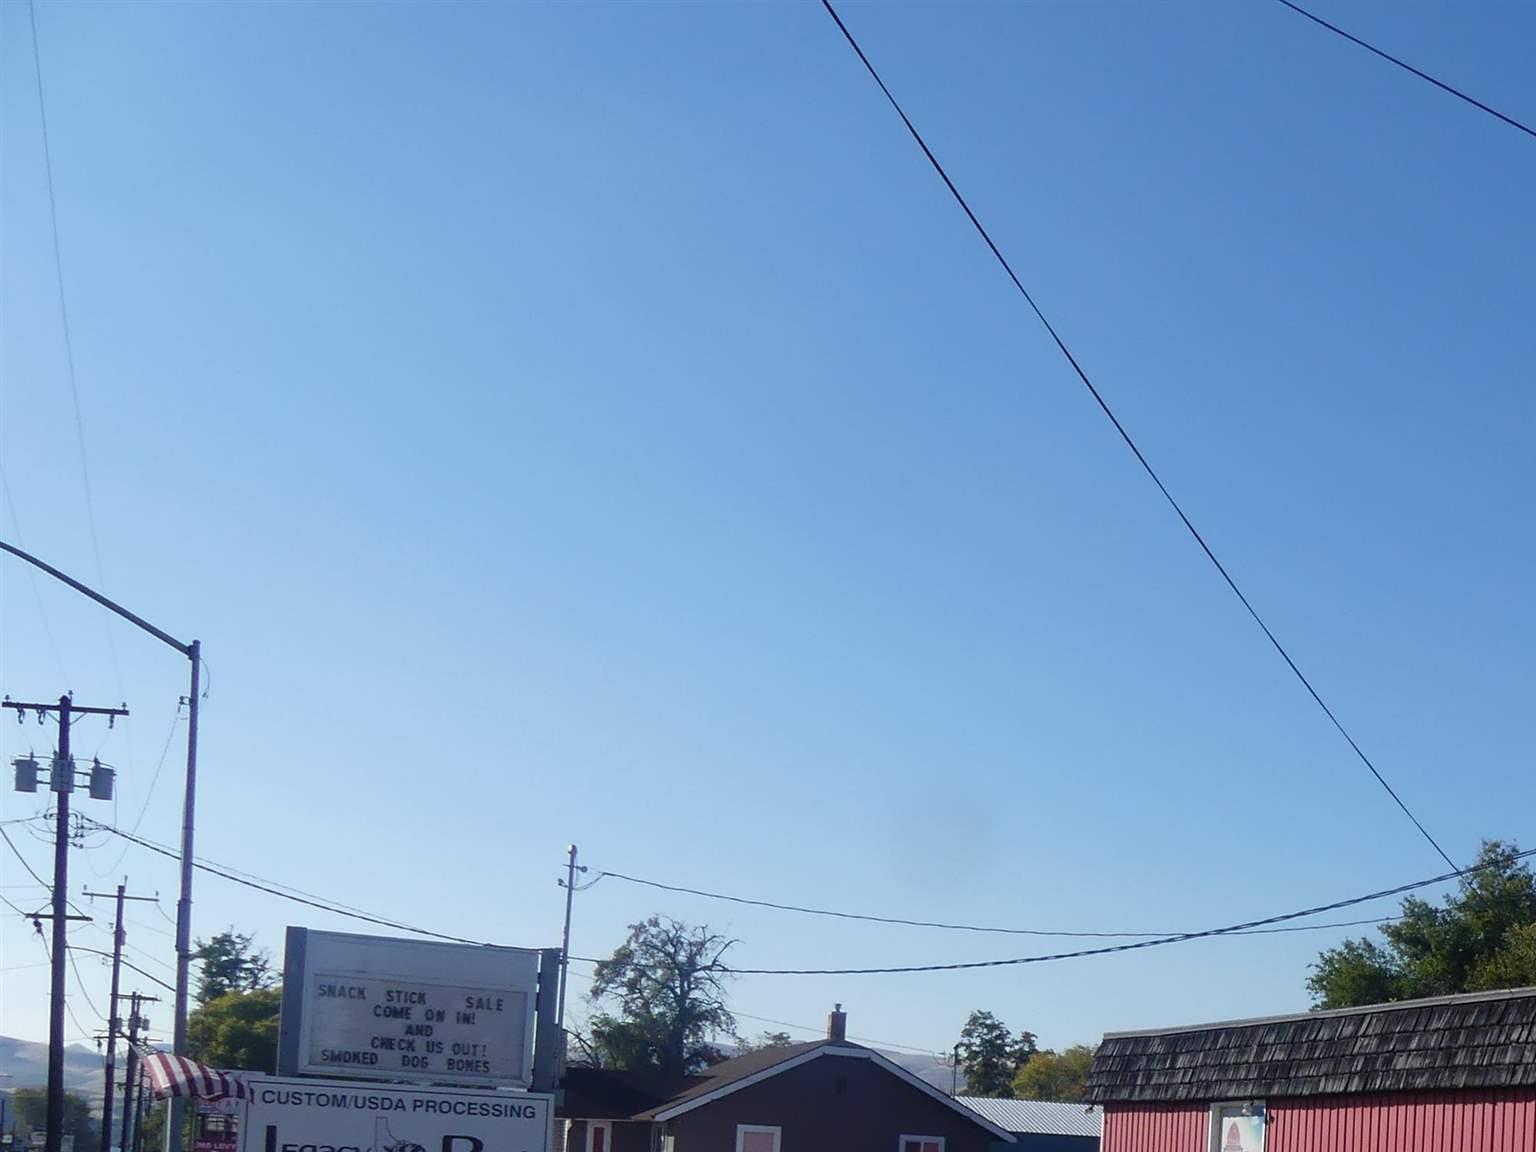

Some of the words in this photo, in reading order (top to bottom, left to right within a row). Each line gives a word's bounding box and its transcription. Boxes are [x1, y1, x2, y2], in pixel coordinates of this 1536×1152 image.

[318, 984, 366, 1000] SNACK
[386, 990, 427, 1005] STICK
[465, 996, 505, 1011] SALE
[373, 1005, 412, 1020] COME
[424, 1009, 445, 1023] ON
[456, 1011, 476, 1025] IN!
[404, 1024, 433, 1037] AND
[371, 1036, 416, 1052] CHECK
[426, 1041, 444, 1054] US
[452, 1043, 487, 1057] OUT!
[321, 1049, 378, 1065] SMOKED
[401, 1055, 429, 1069] DOG
[447, 1058, 490, 1073] BONES
[261, 1090, 407, 1112] CUSTOM/USDA
[412, 1099, 536, 1119] PROCESSING
